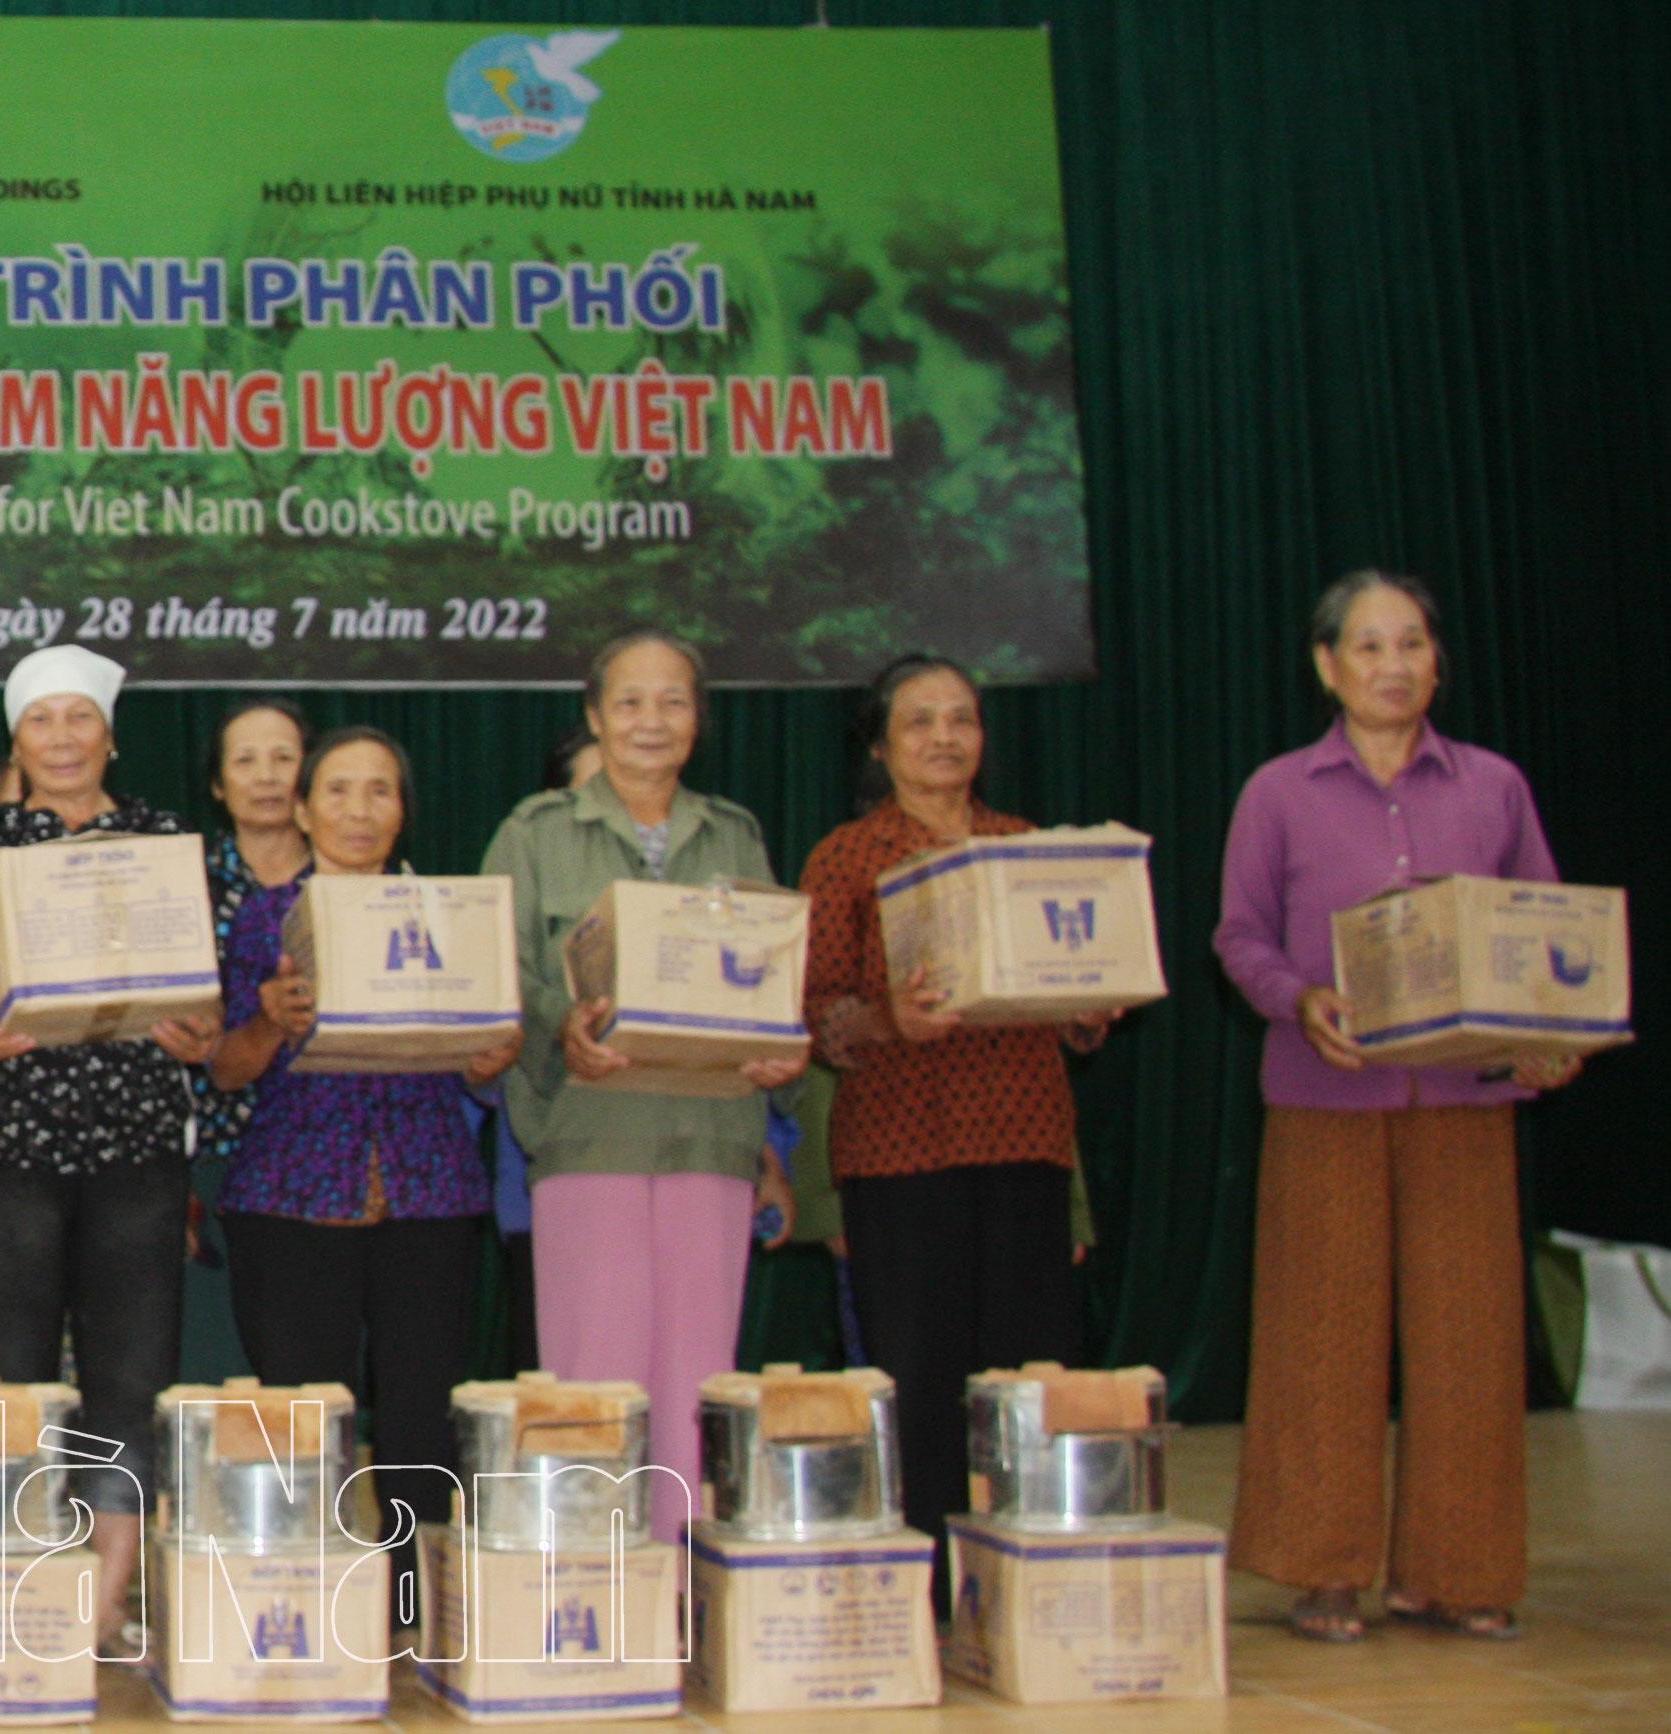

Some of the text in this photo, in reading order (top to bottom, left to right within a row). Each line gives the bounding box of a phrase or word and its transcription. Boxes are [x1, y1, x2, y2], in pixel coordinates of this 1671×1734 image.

[262, 179, 316, 207] HỘI
[325, 180, 396, 205] LIÊN
[405, 181, 478, 209] HIỆP
[744, 188, 817, 210] NAM
[244, 246, 492, 328] PHÂN
[513, 244, 726, 332] PHỐI
[75, 352, 286, 453] NĂNG
[297, 358, 552, 479] LƯỢNG
[558, 358, 715, 482] VIỆT
[728, 375, 892, 458] NAM
[62, 486, 150, 536] Viet
[163, 486, 265, 535] Nam
[278, 485, 497, 537] Cookstove
[510, 487, 692, 551] Program
[76, 598, 134, 640] 28
[145, 598, 278, 649] tháng
[290, 598, 318, 640] 7
[330, 598, 428, 640] năm
[439, 599, 549, 640] 2022
